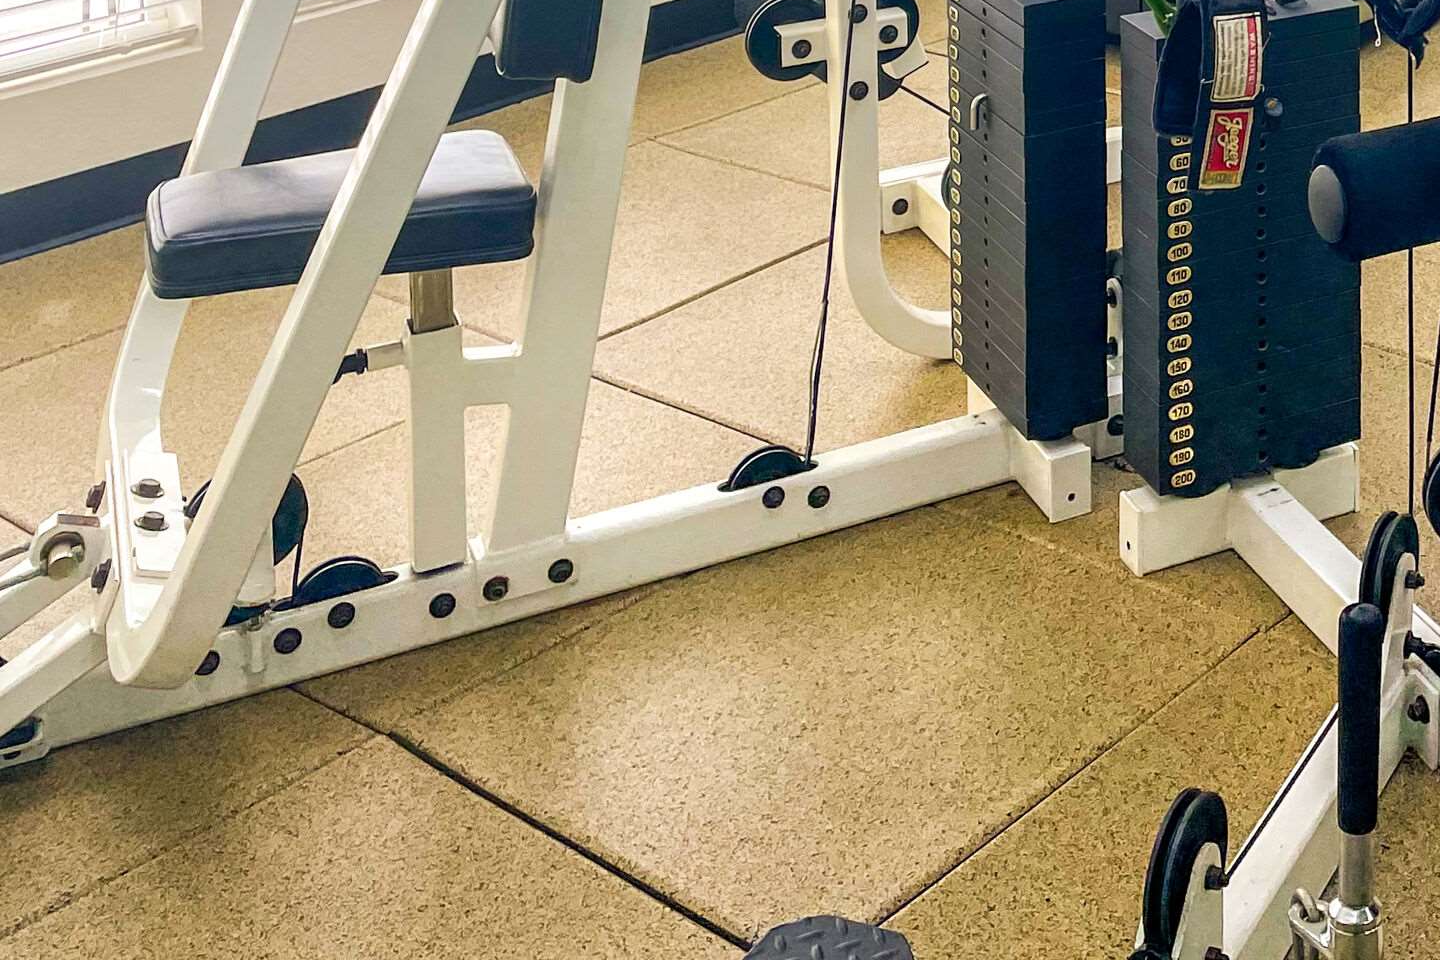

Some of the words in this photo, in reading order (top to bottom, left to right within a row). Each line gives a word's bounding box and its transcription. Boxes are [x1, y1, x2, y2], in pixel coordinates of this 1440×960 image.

[1176, 156, 1189, 168] 60
[1172, 179, 1186, 191] 70
[1173, 202, 1187, 215] 80
[1174, 225, 1187, 236] 90
[1171, 246, 1189, 258] 100
[1171, 270, 1187, 282] 110
[1173, 293, 1189, 306] 120
[1172, 315, 1188, 328] 130
[1170, 337, 1187, 350] 140
[1171, 361, 1187, 373] 150
[1173, 383, 1190, 396] 160
[1172, 405, 1189, 418] 170
[1174, 428, 1190, 441] 180
[1173, 449, 1190, 462] 190
[1175, 471, 1193, 485] 200
